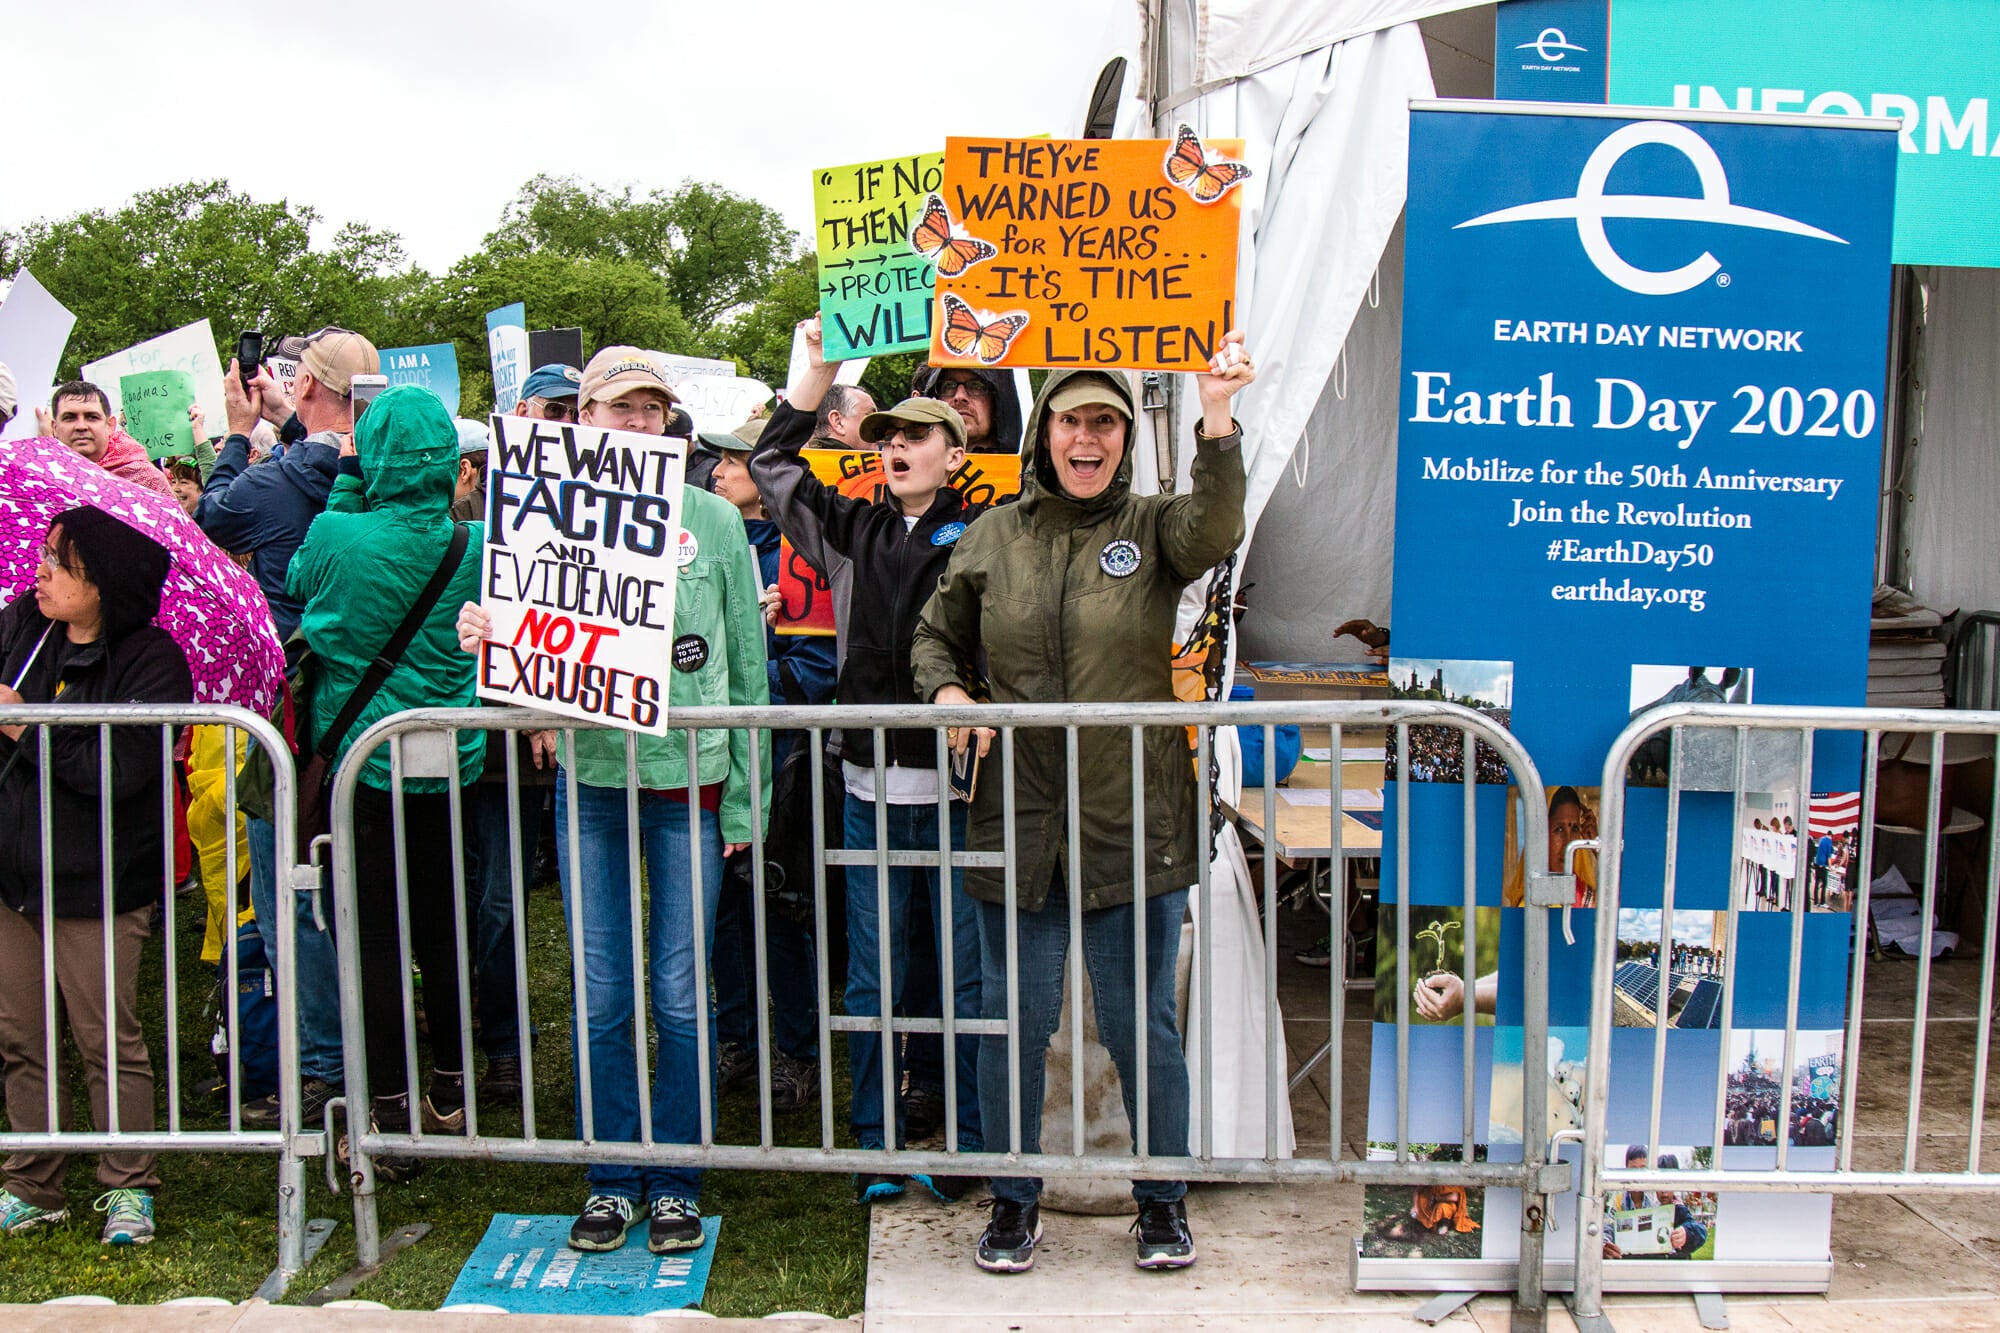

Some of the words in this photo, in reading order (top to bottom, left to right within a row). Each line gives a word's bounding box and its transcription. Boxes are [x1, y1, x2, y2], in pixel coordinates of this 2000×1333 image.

[893, 156, 945, 198] NO
[957, 181, 1111, 222] WARNED
[1079, 264, 1193, 300] TIME
[834, 297, 934, 350] WIL
[1050, 302, 1089, 322] TO
[1494, 320, 1588, 344] EARTH
[1596, 323, 1651, 347] DAY
[1658, 325, 1804, 353] NETWORK
[389, 355, 395, 370] I
[398, 353, 418, 369] AM
[421, 352, 431, 367] A
[1408, 371, 1574, 428] Earth
[1592, 377, 1716, 449] Day
[1730, 385, 1875, 439] 2020
[492, 416, 561, 480] WE
[561, 427, 679, 496] WANT
[839, 452, 885, 480] GE
[1422, 457, 1534, 484] Mobilize
[1541, 460, 1577, 485] for
[1584, 463, 1623, 487] the
[1629, 465, 1687, 488] 50th
[1693, 467, 1844, 500] Anniversary
[487, 469, 670, 558] FACTS
[1508, 499, 1563, 527] Join
[1570, 501, 1610, 524] the
[1615, 503, 1752, 529] Revolution
[536, 541, 595, 566] AND
[1546, 540, 1714, 572] #EarthDay50
[488, 548, 665, 631] EVIDENCE
[1551, 578, 1706, 612] earthday.org
[512, 607, 620, 665] NOT
[677, 641, 699, 652] POWER
[688, 648, 700, 656] THE
[678, 653, 704, 664] PEOPLE
[481, 640, 660, 728] EXCUSES
[1809, 1055, 1835, 1067] EARTH
